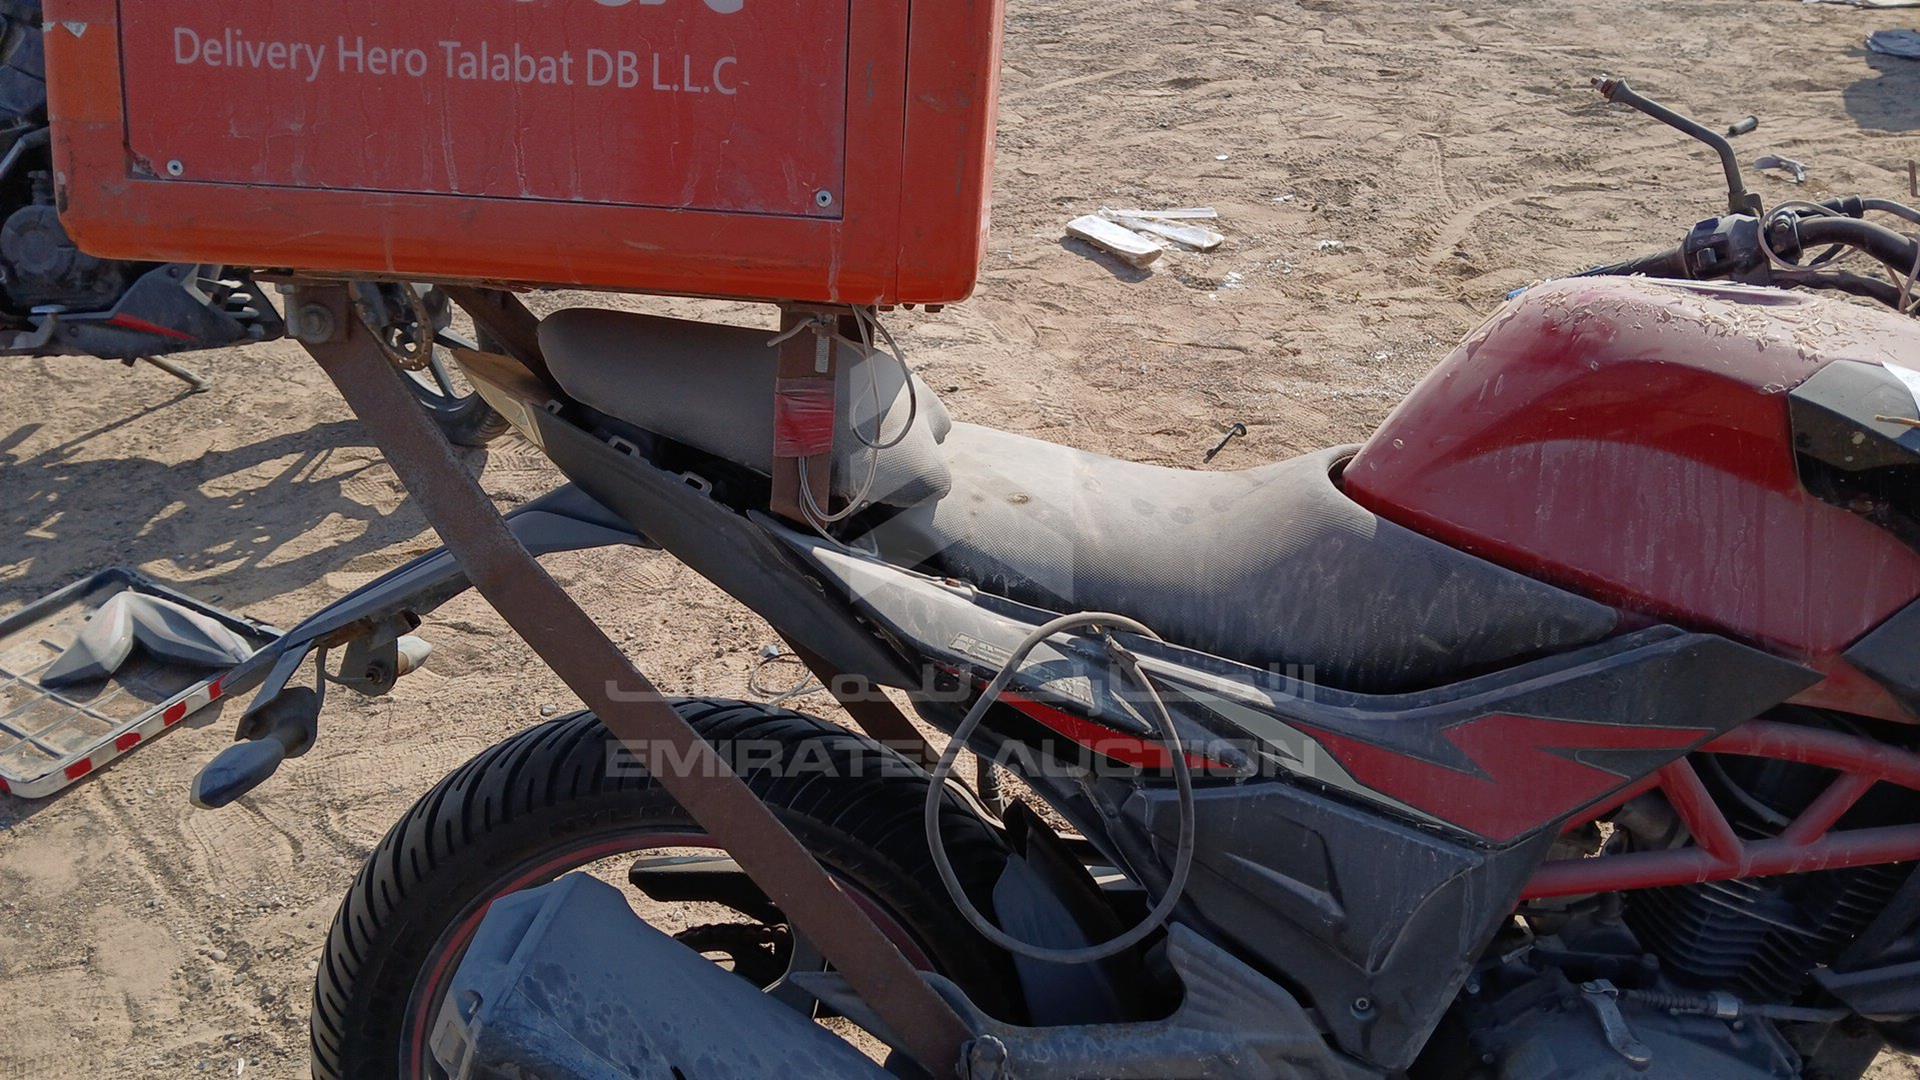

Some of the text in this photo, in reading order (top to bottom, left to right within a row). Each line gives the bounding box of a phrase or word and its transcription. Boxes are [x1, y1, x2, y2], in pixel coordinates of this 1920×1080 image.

[173, 26, 738, 96] Delivery Hero Talabat DB L.L.C
